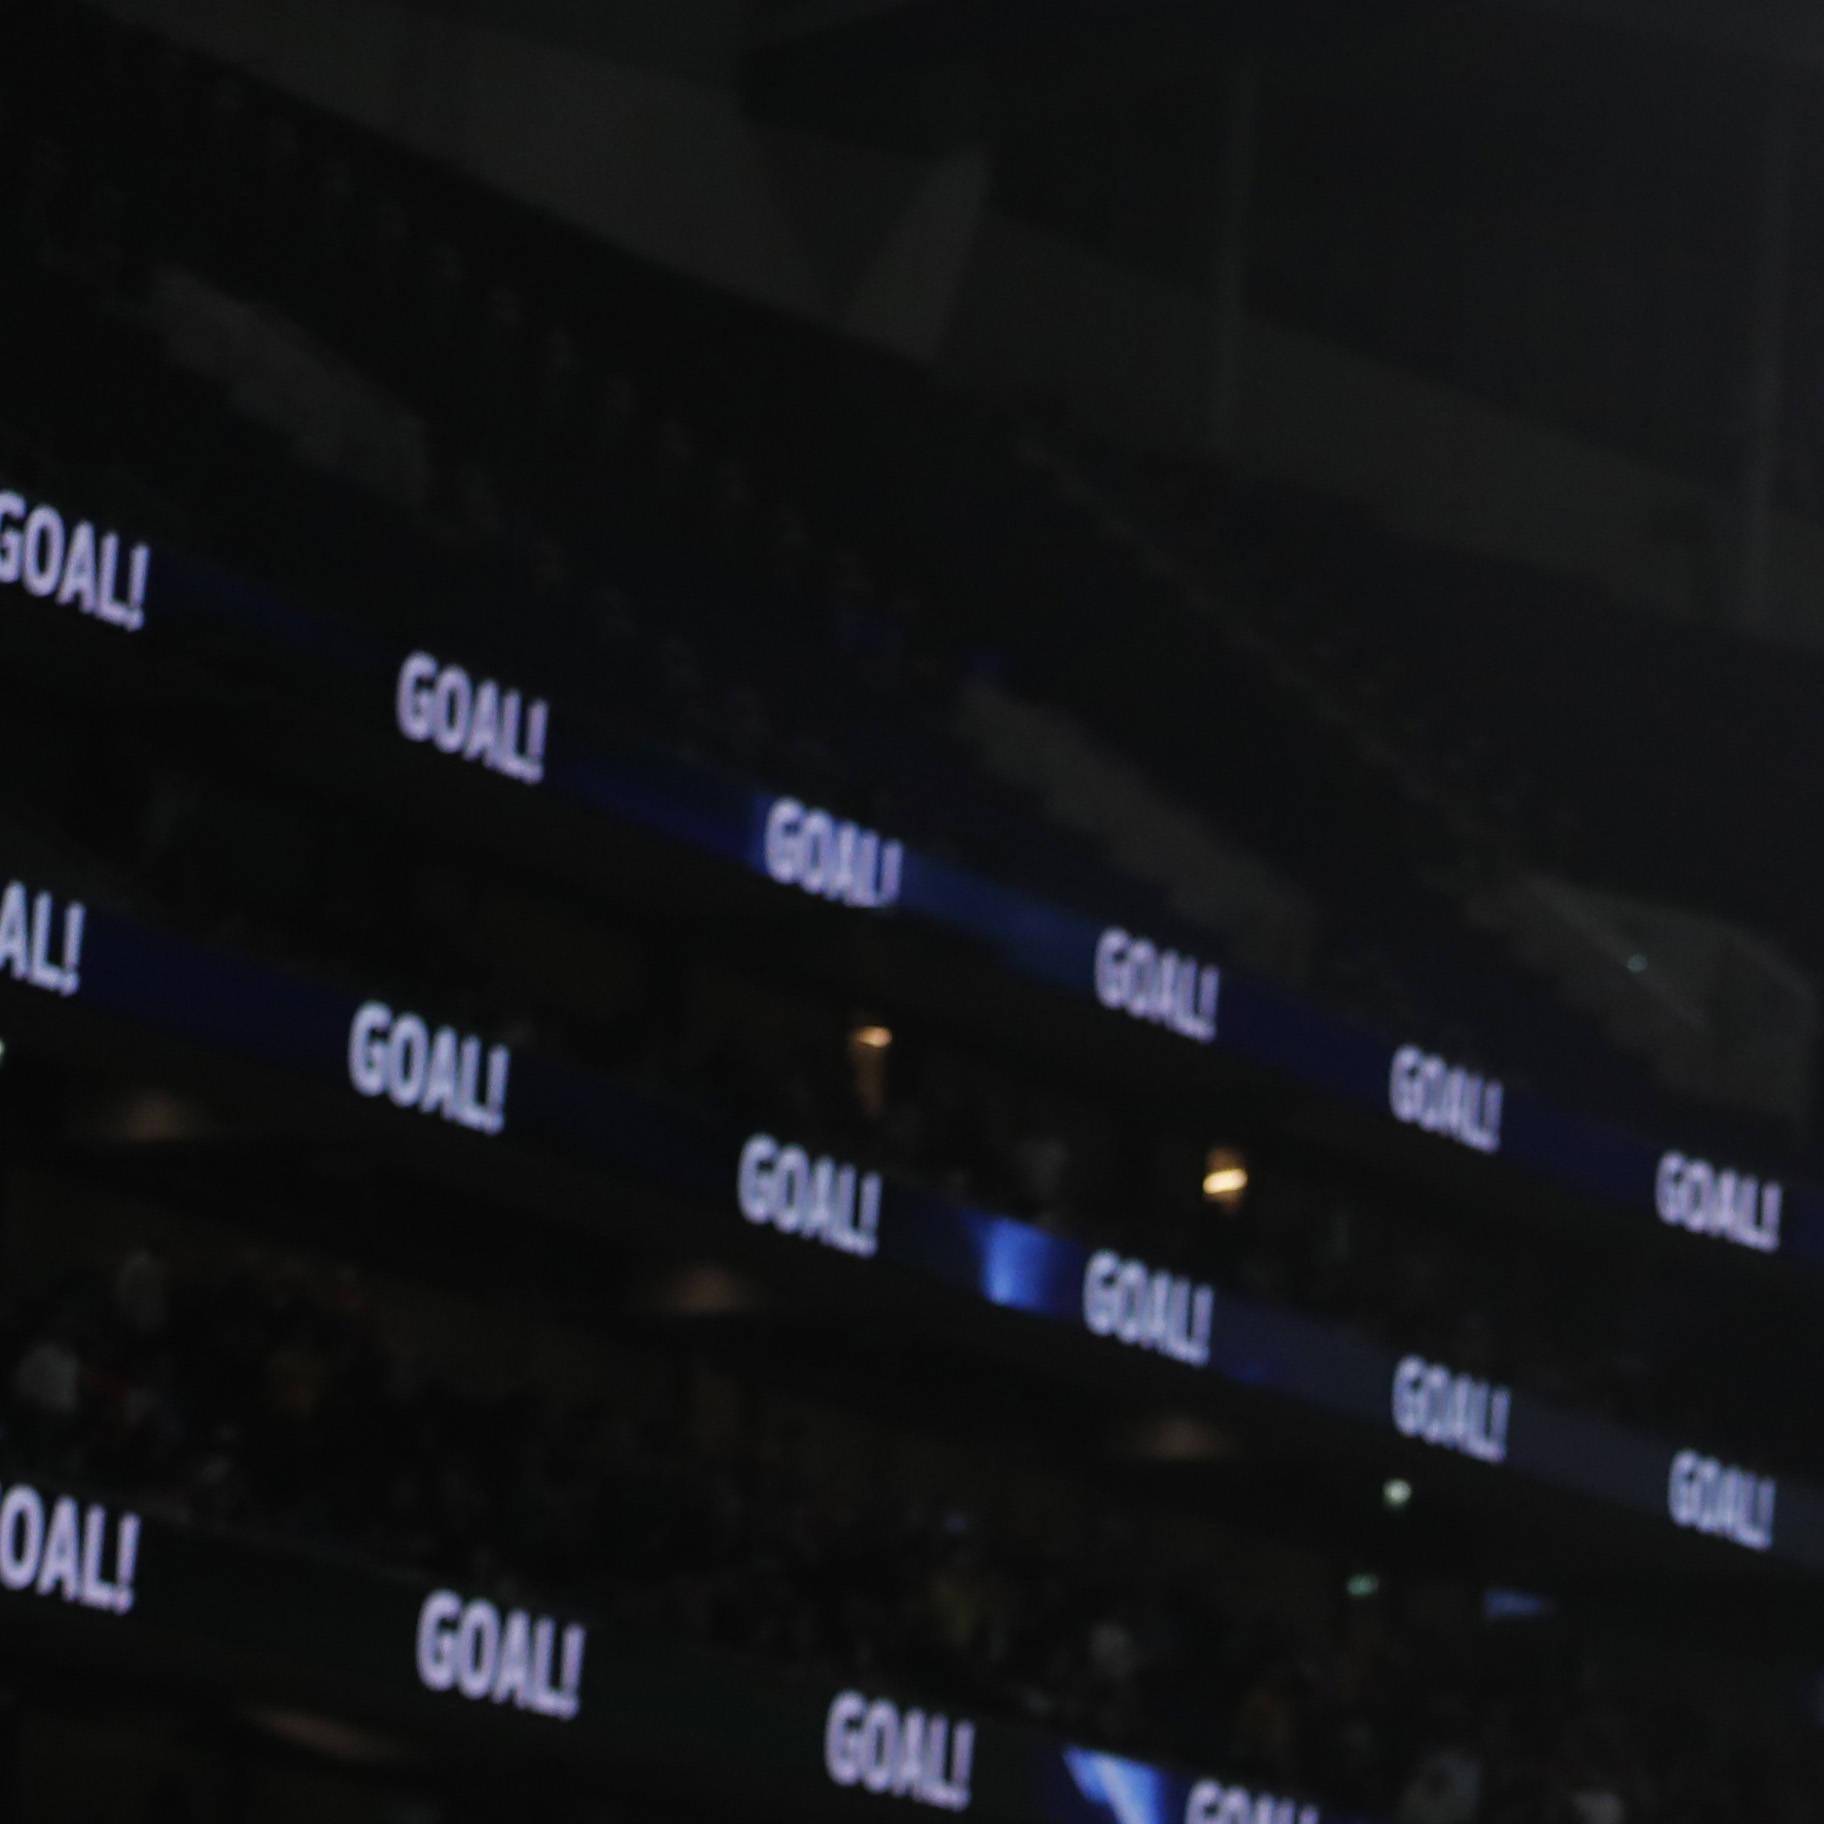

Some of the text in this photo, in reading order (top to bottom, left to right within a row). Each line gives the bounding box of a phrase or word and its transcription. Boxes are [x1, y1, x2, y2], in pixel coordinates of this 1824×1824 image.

[396, 650, 549, 785] GOAL!
[764, 796, 904, 909] GOAL!
[1094, 927, 1221, 1042] GOAL!
[348, 1001, 510, 1134] GOAL!
[1388, 1043, 1504, 1153] GOAL!
[737, 1133, 882, 1257] GOAL!
[1655, 1151, 1783, 1253] GOAL!
[1082, 1249, 1215, 1366] GOAL!
[1391, 1355, 1511, 1464] GOAL!
[1667, 1448, 1776, 1552] GOAL!
[416, 1589, 586, 1720] GOAL!
[824, 1690, 976, 1811] GOAL!
